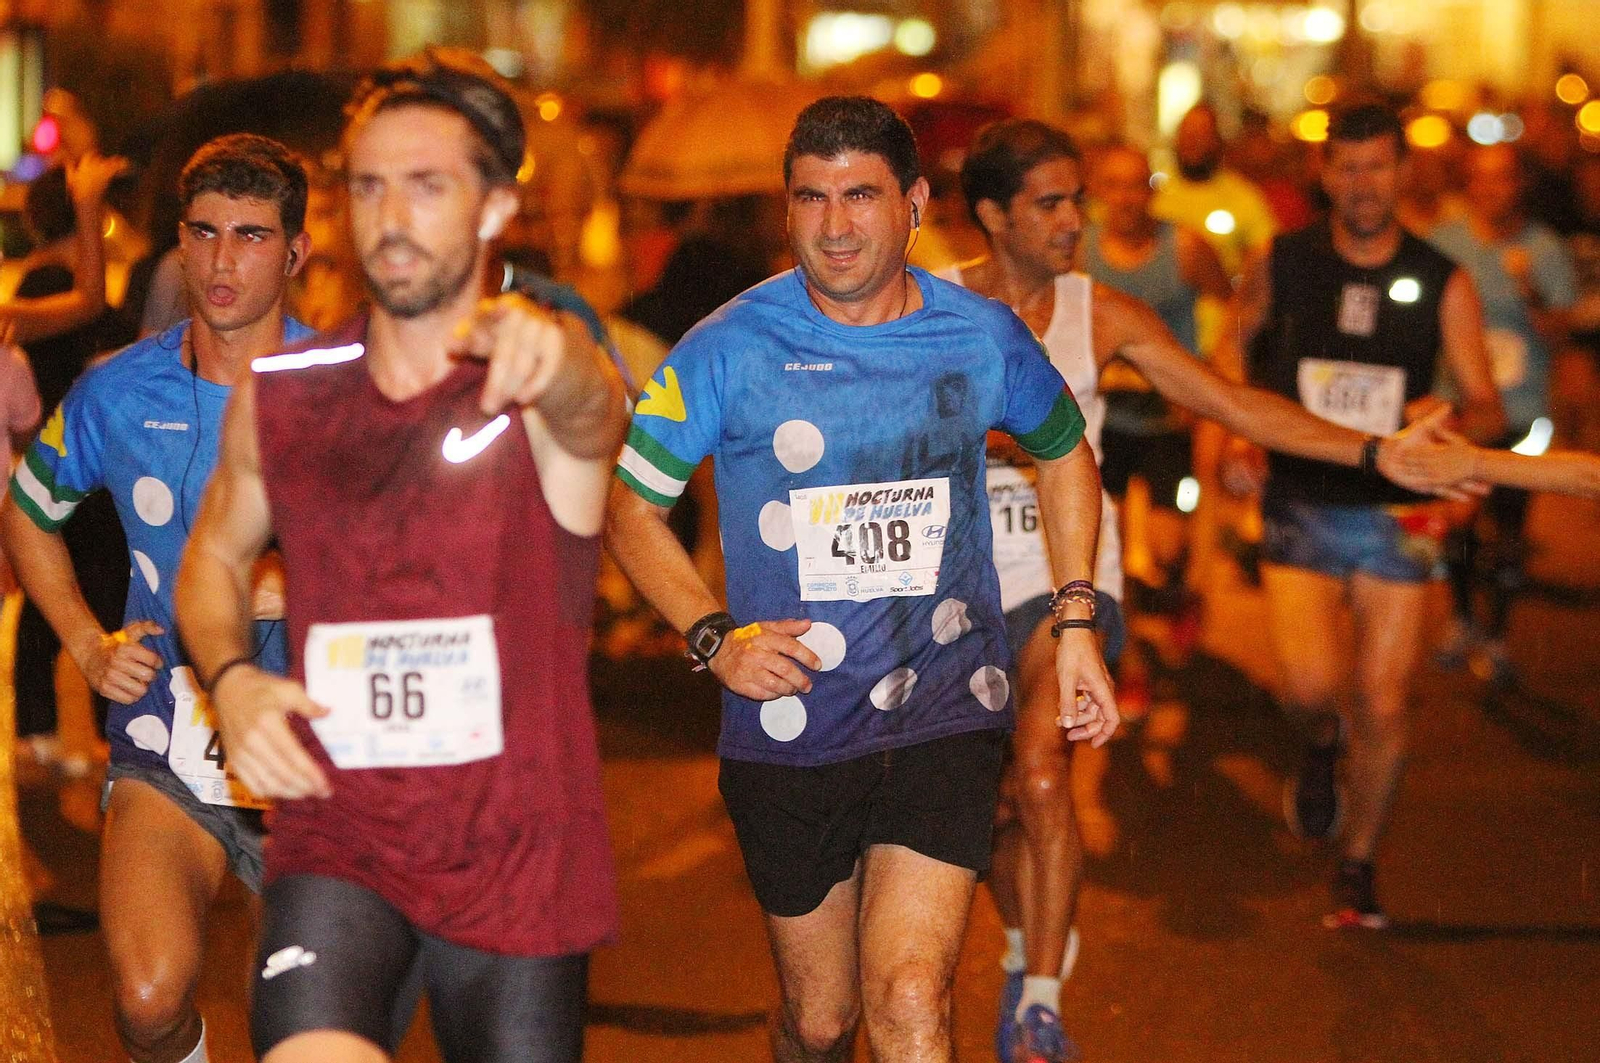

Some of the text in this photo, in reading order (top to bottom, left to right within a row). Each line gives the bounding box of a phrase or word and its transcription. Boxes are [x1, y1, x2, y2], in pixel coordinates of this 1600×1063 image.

[845, 486, 935, 508] NOCTURNA
[869, 502, 933, 521] HUELVA
[830, 519, 912, 566] 408
[370, 671, 426, 720] 66
